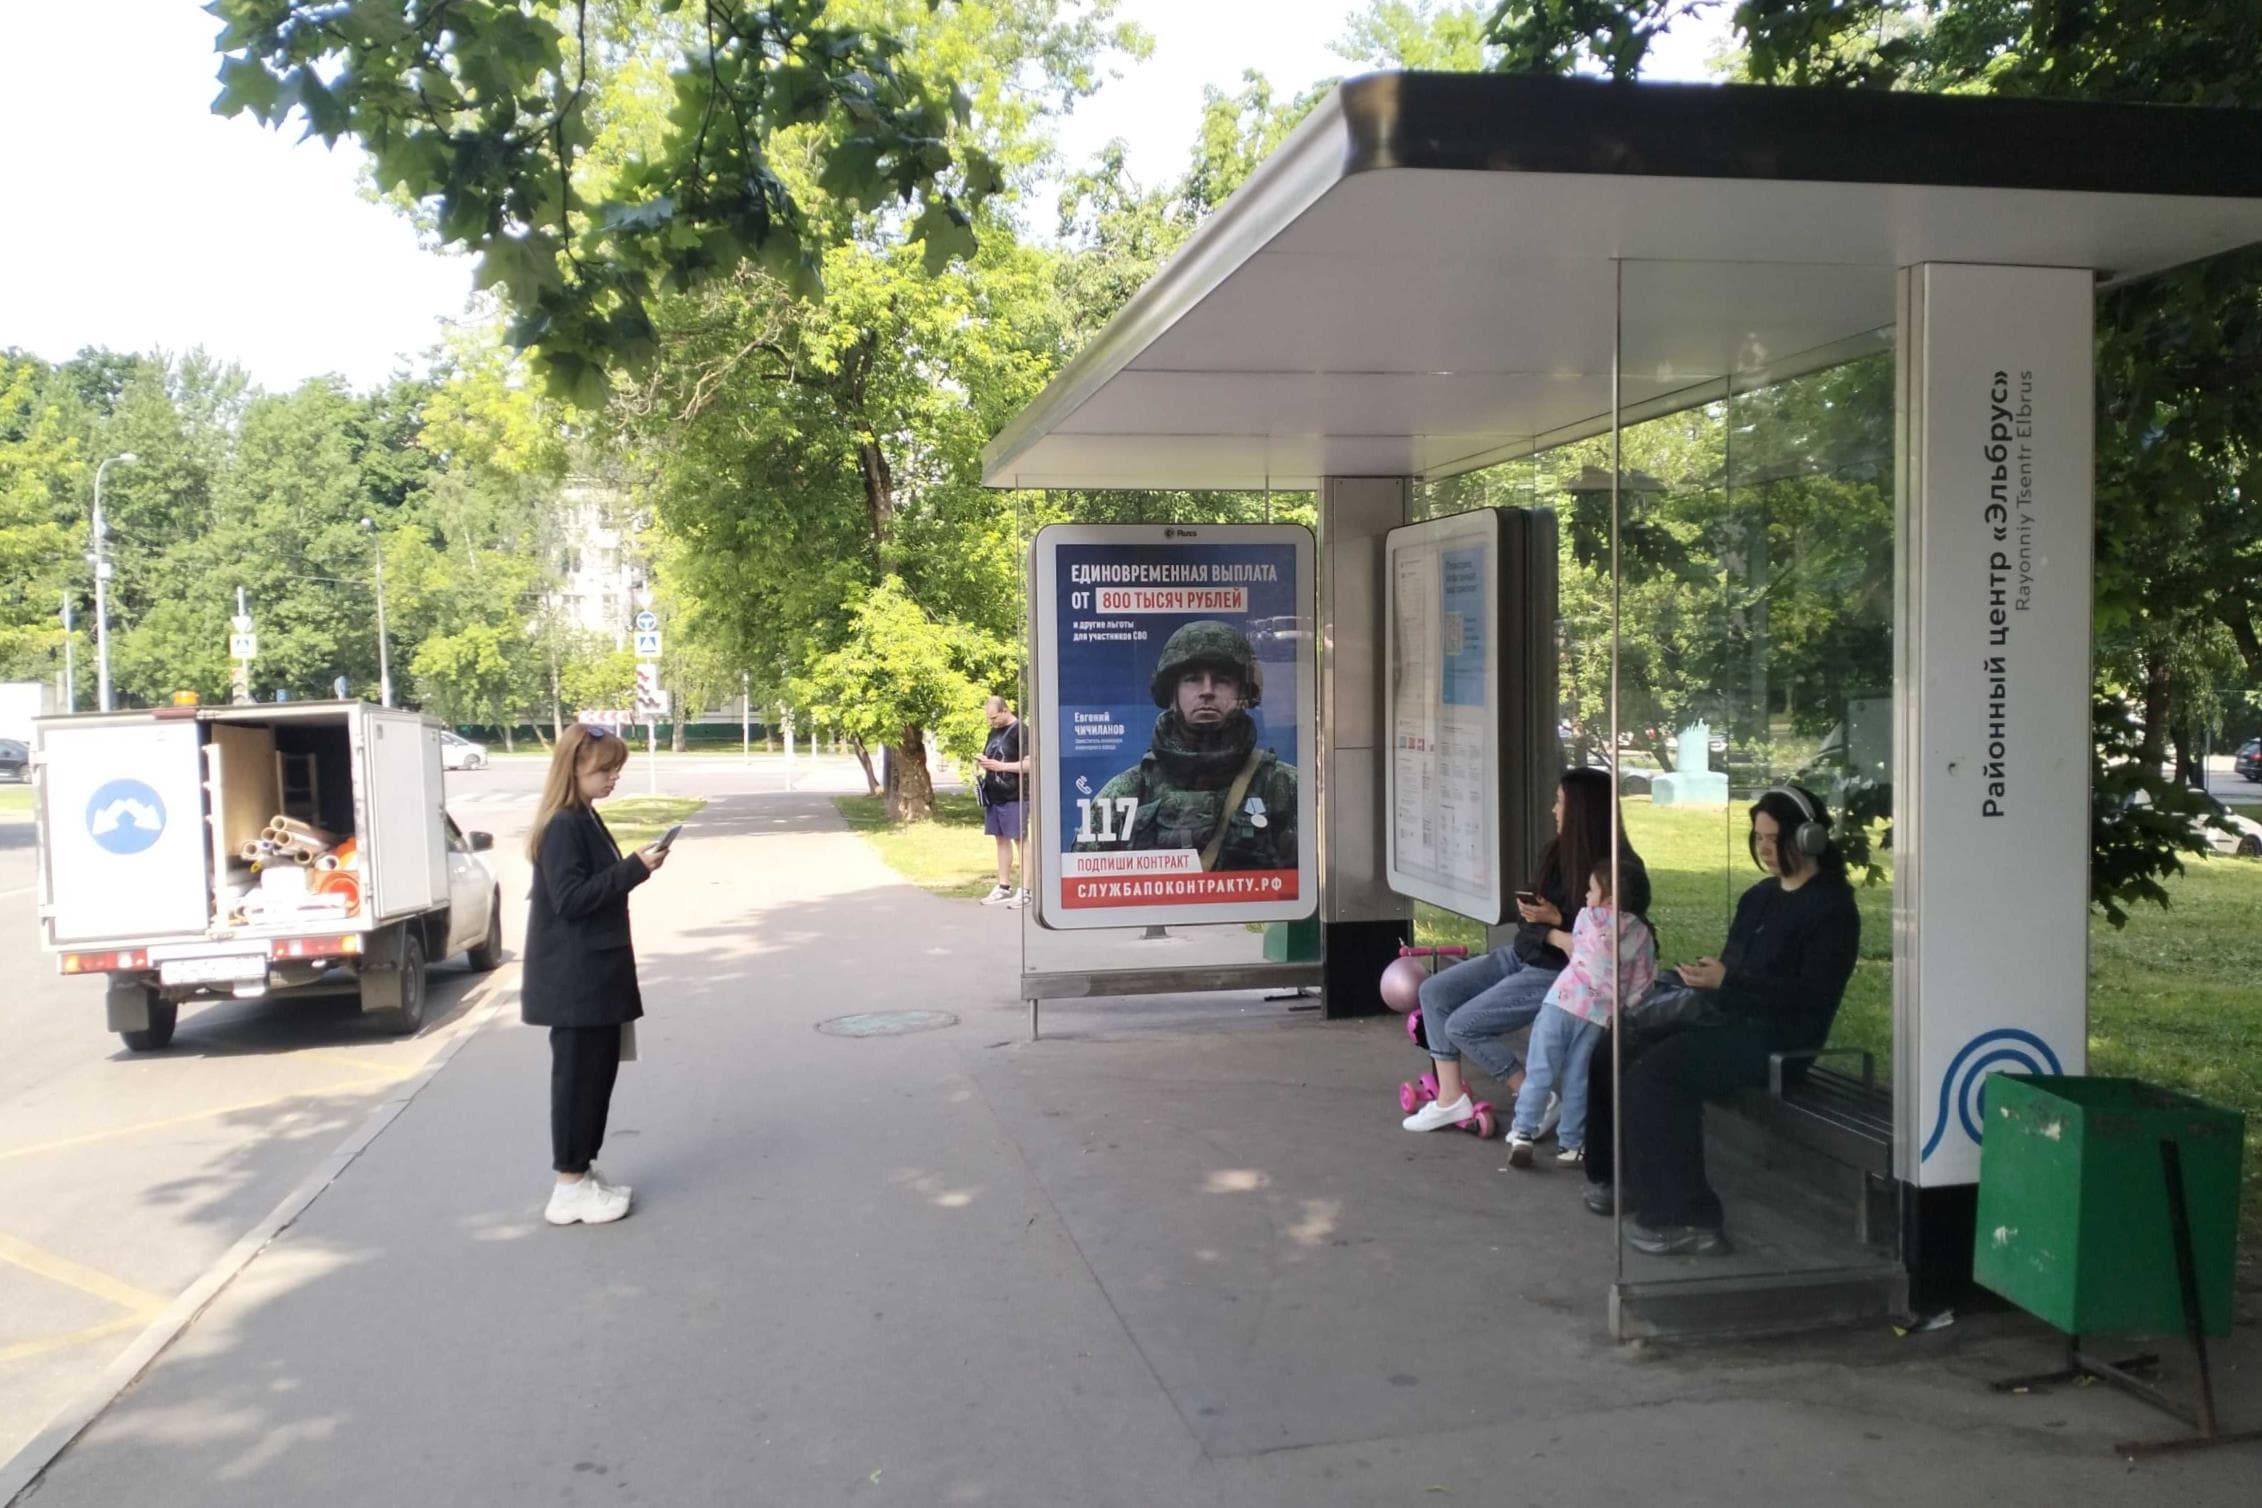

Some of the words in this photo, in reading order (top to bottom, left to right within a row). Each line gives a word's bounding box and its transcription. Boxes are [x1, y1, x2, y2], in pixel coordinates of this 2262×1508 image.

[2016, 370, 2032, 438] Elbrus
[1984, 370, 2013, 542] «Эльбрус»
[2015, 444, 2032, 507] Tsentr
[2015, 513, 2034, 612] Rayonniy
[1071, 564, 1207, 584] ЕДИНОВРЕМЕННАЯ
[1212, 564, 1277, 581] ВЫПЛАТА
[1072, 591, 1090, 609] ОТ
[1103, 592, 1131, 609] 800
[1134, 592, 1183, 609] ТЫСЯЧ
[1187, 588, 1242, 608] РУБЛЕЙ
[1986, 551, 2011, 646] центр
[1073, 632, 1088, 641] для
[1088, 632, 1132, 642] участников
[1133, 631, 1148, 640] СВО
[1079, 621, 1106, 630] другие
[1107, 621, 1134, 629] льготы
[1074, 711, 1110, 722] Евгений
[1074, 724, 1125, 736] ЧИЧИЛАНОВ
[1982, 656, 2007, 819] Районный
[1076, 797, 1138, 843] 117
[1077, 857, 1134, 873] ПОДПИШИ
[1136, 854, 1190, 870] КОНТРАКТ
[1078, 876, 1283, 898] СЛУЖБАПОКОНТРАКТУ.РФ
